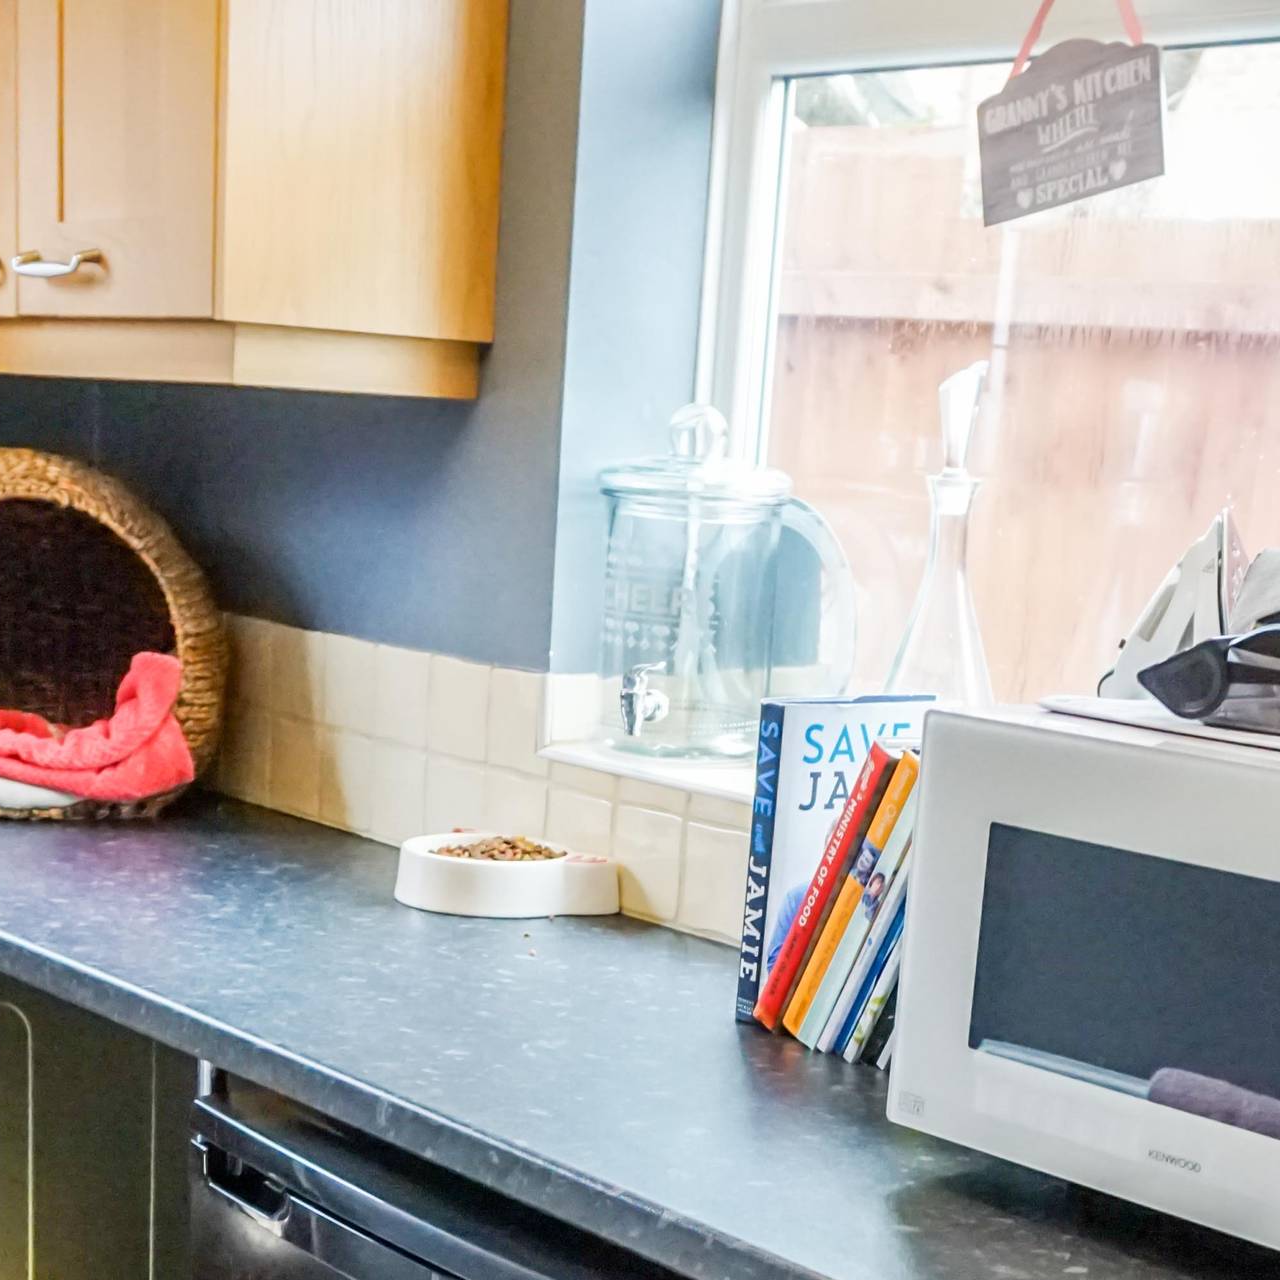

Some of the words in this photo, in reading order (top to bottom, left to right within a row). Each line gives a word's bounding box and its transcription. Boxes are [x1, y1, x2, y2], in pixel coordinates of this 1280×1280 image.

[984, 83, 1068, 135] GRANNY'S
[1073, 55, 1152, 105] KITCHEN
[1037, 103, 1098, 146] WHERE
[1035, 166, 1109, 204] SPECIAL
[754, 720, 780, 817] SAVE
[826, 798, 858, 866] MINISTRY
[817, 865, 829, 888] OF
[740, 856, 767, 983] JAMIE
[799, 886, 820, 928] FOOD
[1147, 1148, 1202, 1174] KENWOOD
